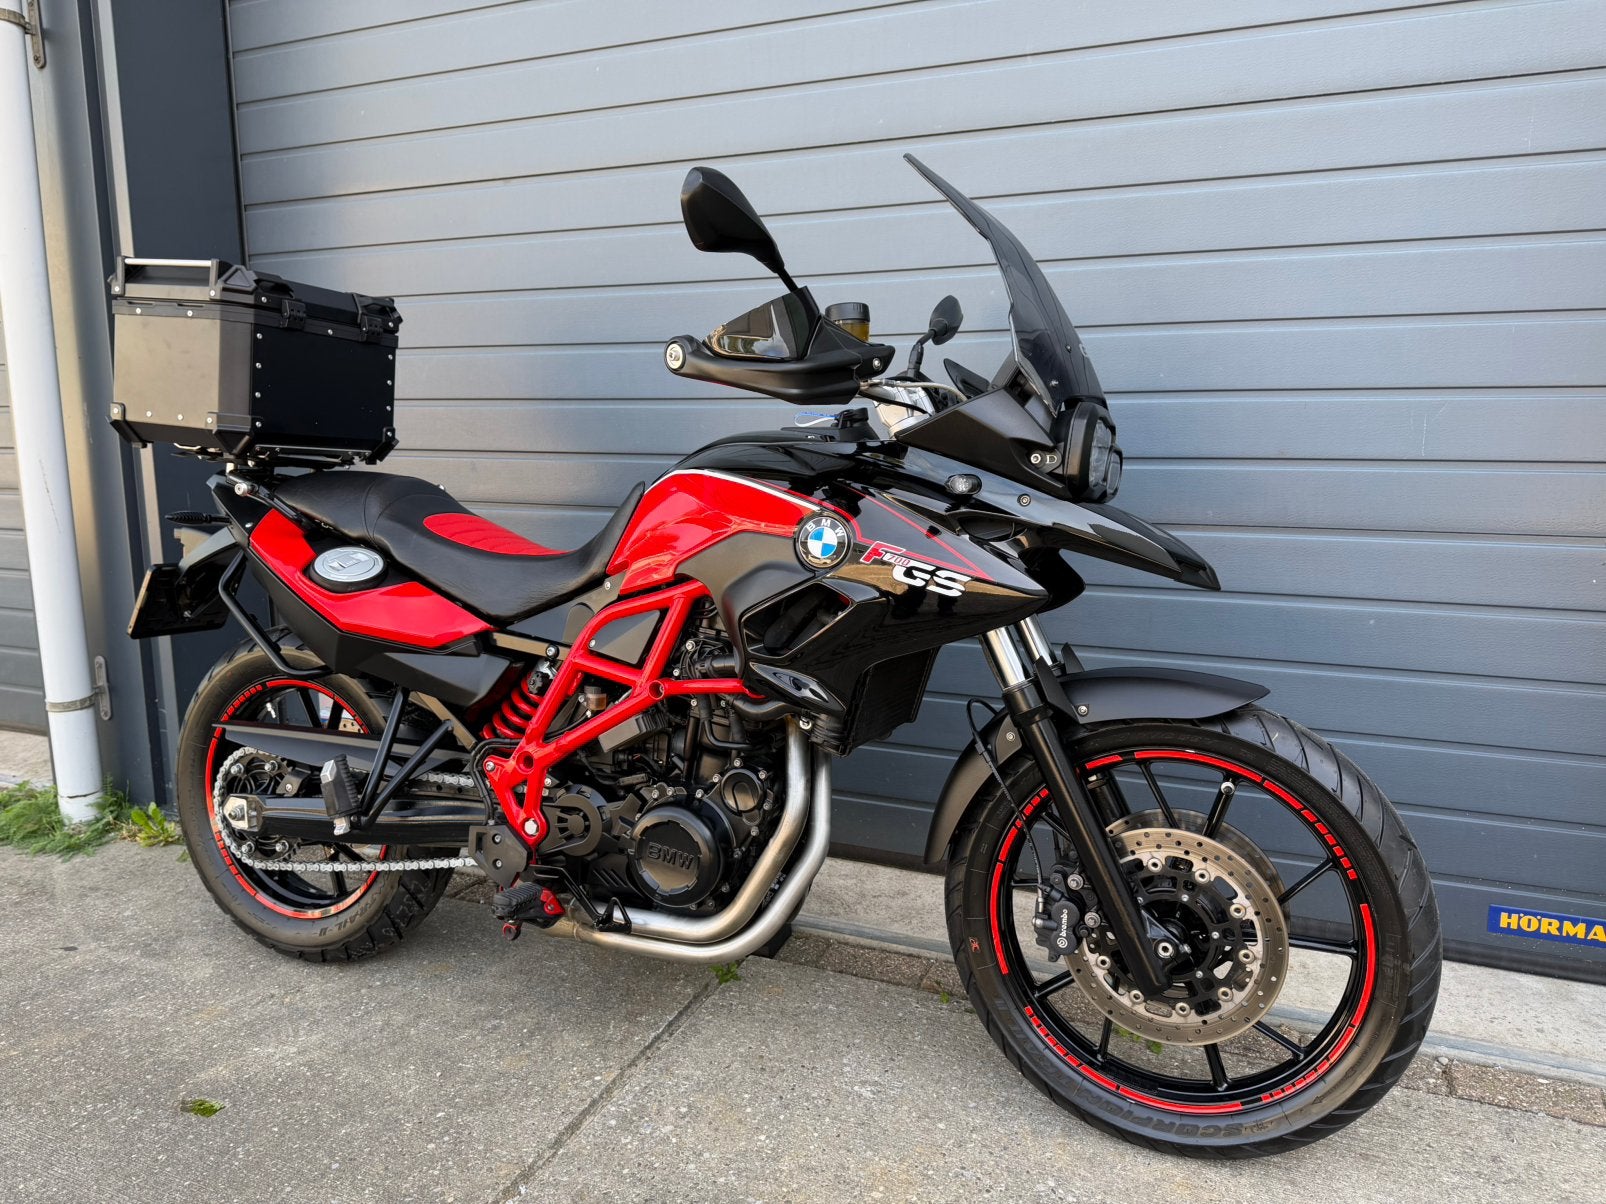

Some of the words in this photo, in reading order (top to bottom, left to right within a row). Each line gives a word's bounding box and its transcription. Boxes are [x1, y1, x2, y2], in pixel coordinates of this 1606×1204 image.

[806, 519, 845, 537] BMW
[886, 554, 972, 597] GS
[647, 842, 694, 870] BMW
[1059, 908, 1068, 937] brembo
[1499, 911, 1606, 942] HÖRMA
[1076, 1089, 1244, 1138] SCORPION
